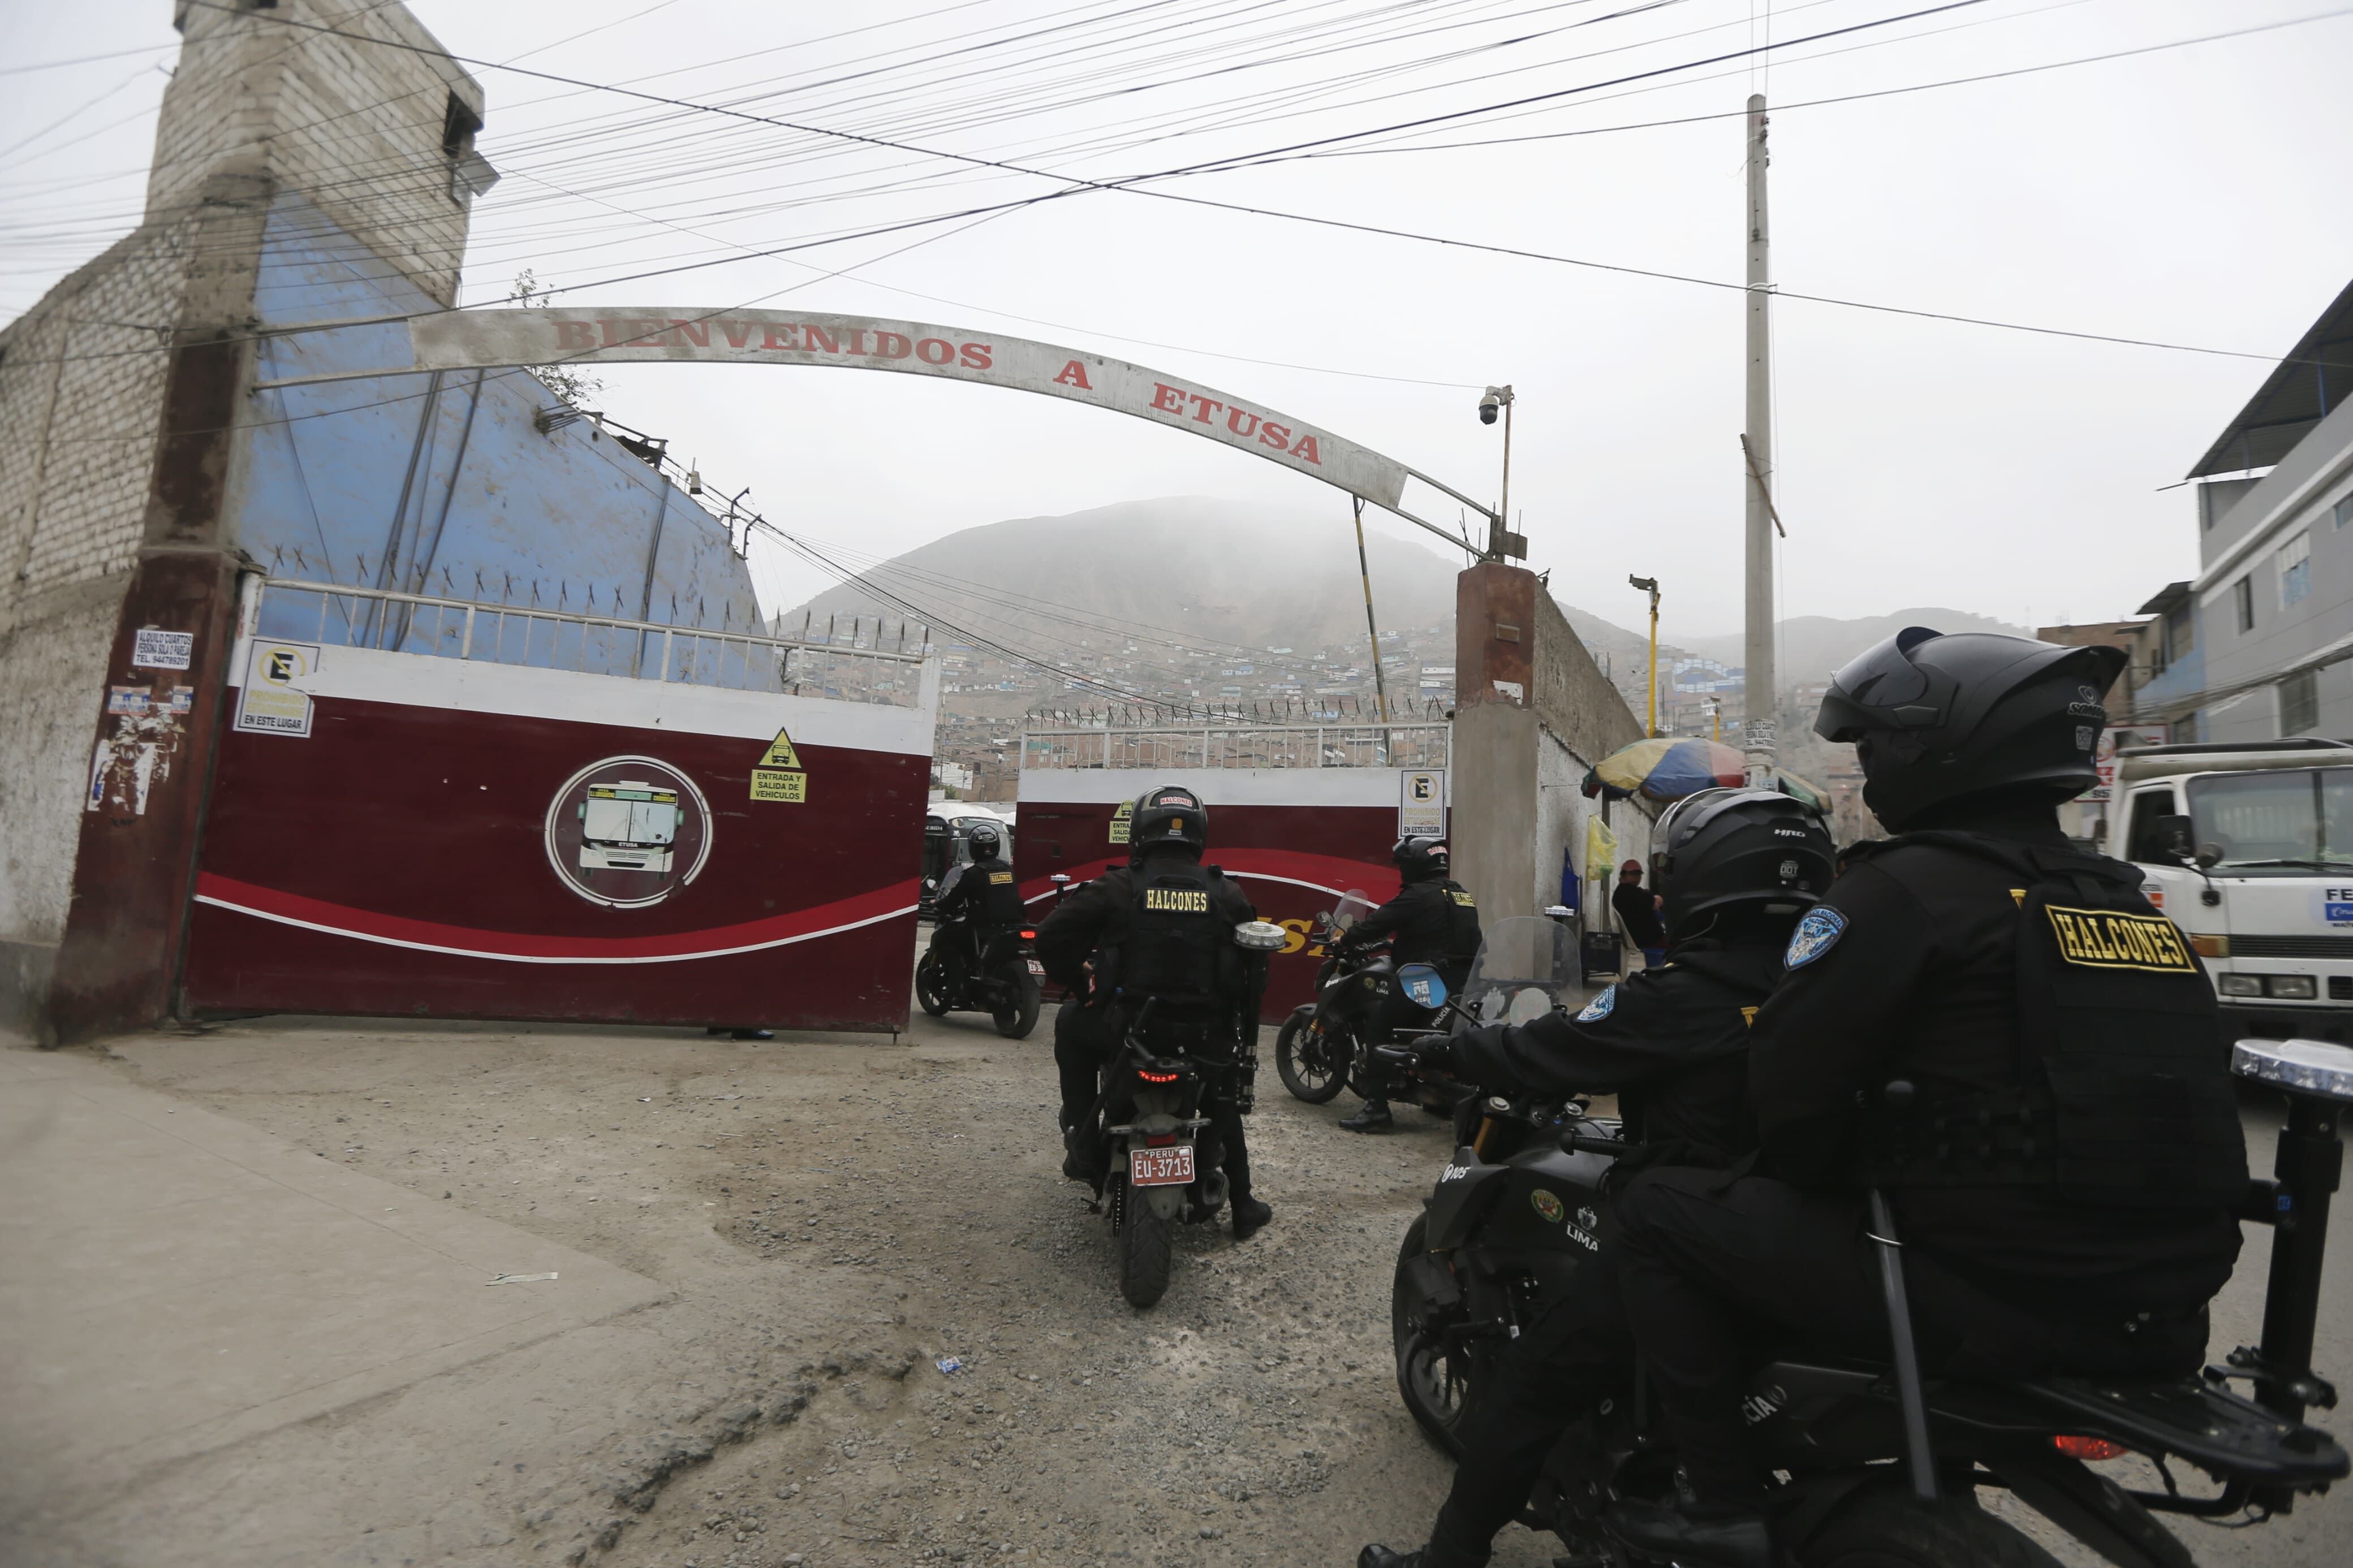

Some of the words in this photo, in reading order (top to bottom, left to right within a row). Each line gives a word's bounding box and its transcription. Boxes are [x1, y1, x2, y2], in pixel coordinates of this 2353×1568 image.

[551, 318, 993, 370] BIENVENIDOS
[1053, 360, 1093, 390] A
[1149, 382, 1322, 466] ETUSA
[139, 632, 163, 643] ALQUILO
[165, 633, 192, 645] CUARTOS
[138, 642, 157, 654] PERSONA
[158, 643, 169, 655] SOLA
[249, 689, 305, 706] PROHIBIDO
[244, 715, 255, 724] EN
[256, 716, 276, 727] ESTE
[277, 718, 302, 729] LUGAR
[757, 772, 794, 781] ENTRADA
[756, 790, 800, 800] VEHICULOS
[1161, 797, 1192, 806] HALCONES
[1780, 865, 1799, 874] DOT
[1147, 889, 1207, 912] HALCONES
[2055, 914, 2184, 965] HALCONES
[1149, 1149, 1174, 1159] PERU
[1135, 1157, 1191, 1179] EU-3713
[1567, 1224, 1598, 1251] LIMA
